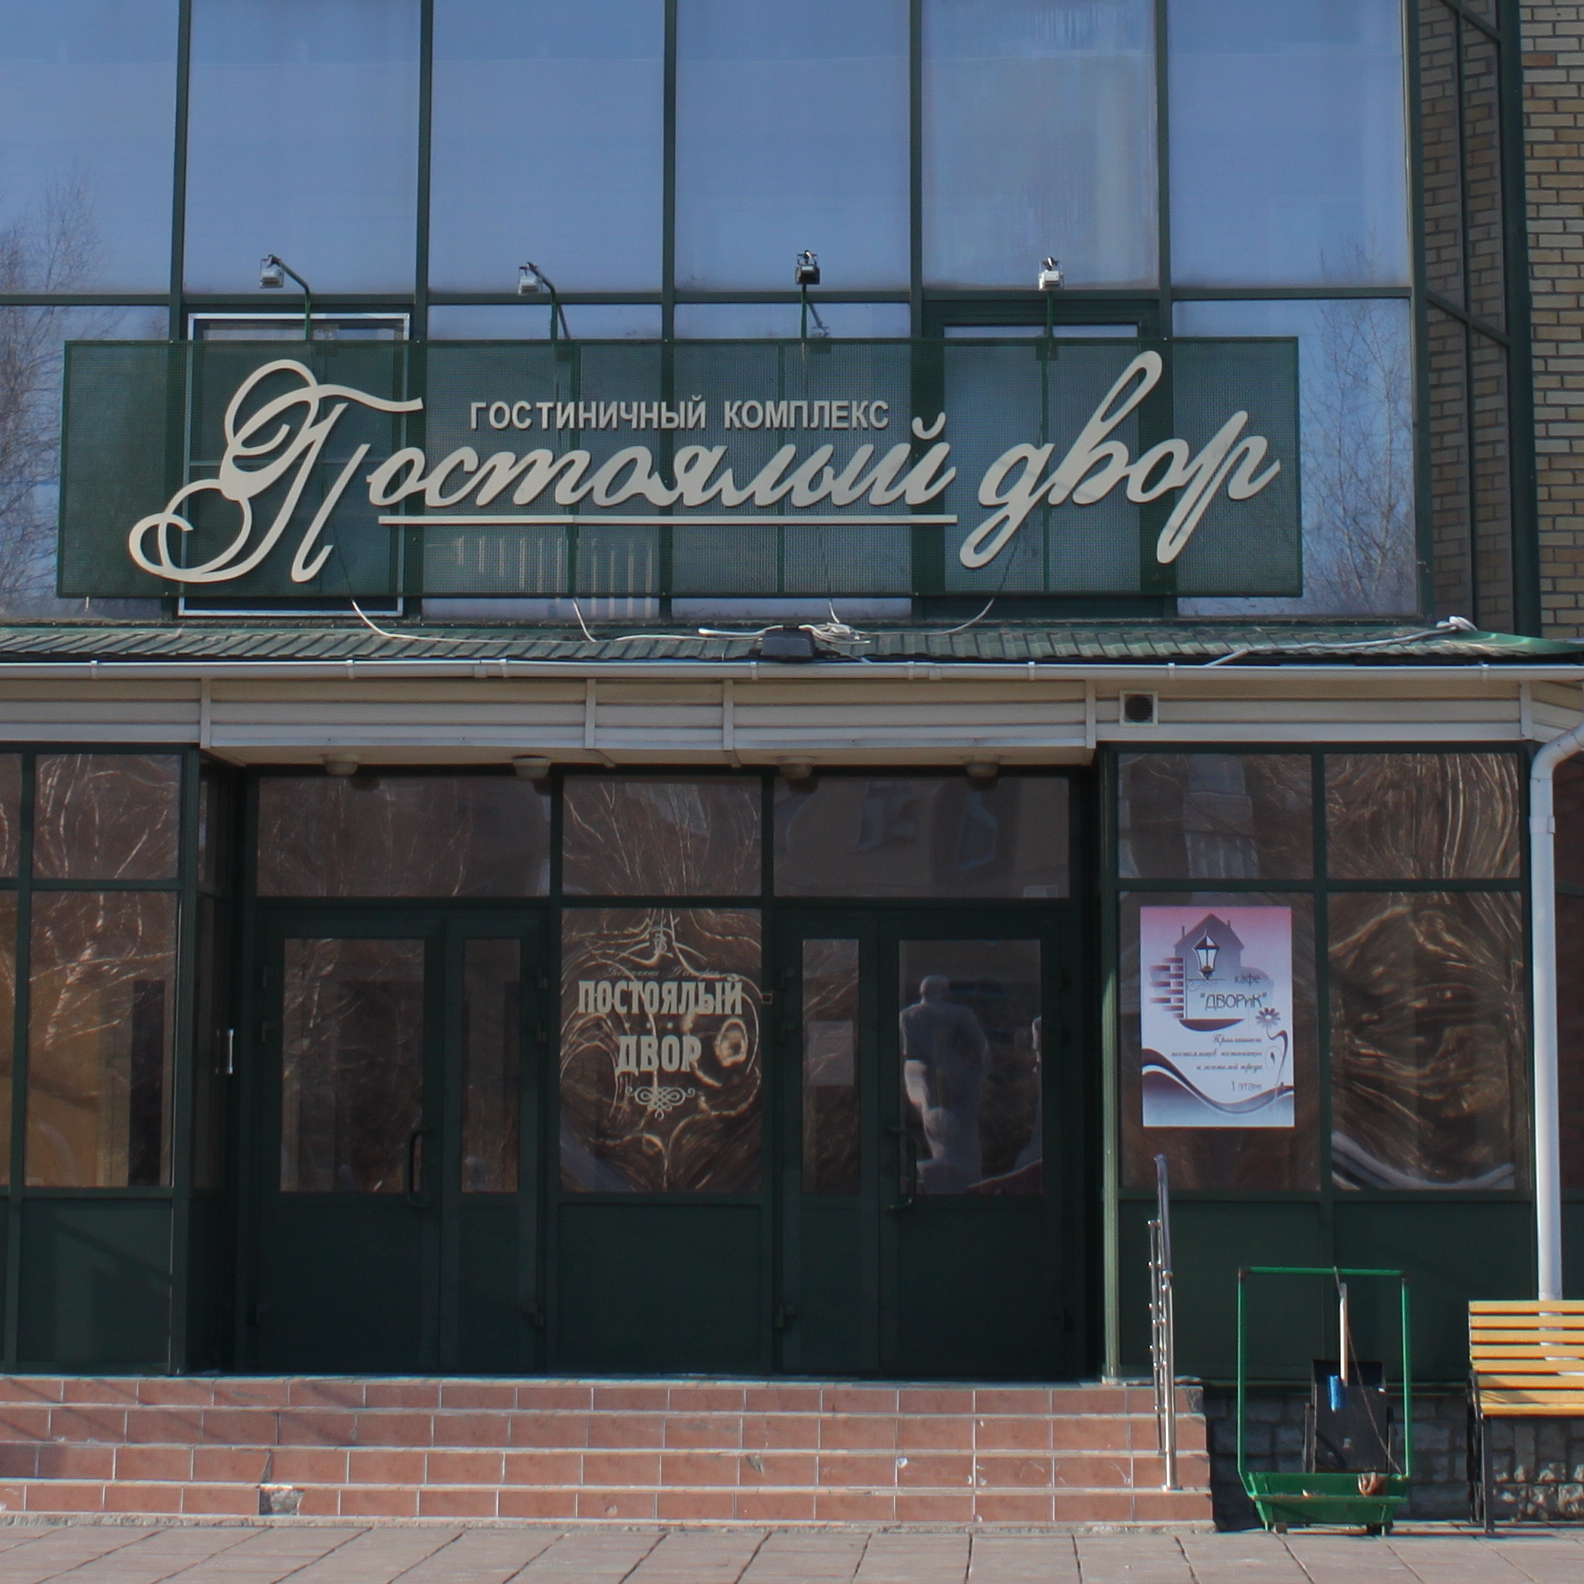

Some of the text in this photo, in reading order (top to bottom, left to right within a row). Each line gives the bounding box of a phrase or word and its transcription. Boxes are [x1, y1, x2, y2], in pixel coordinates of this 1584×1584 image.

[470, 394, 890, 430] ГОСТИНИЧНЫЙ КОМПЛЕКС
[128, 350, 1281, 584] Постоялый двор
[578, 979, 743, 1015] ПОСТОЯЛЫЙ
[1234, 973, 1261, 986] кафе
[615, 1035, 702, 1076] ДВОР
